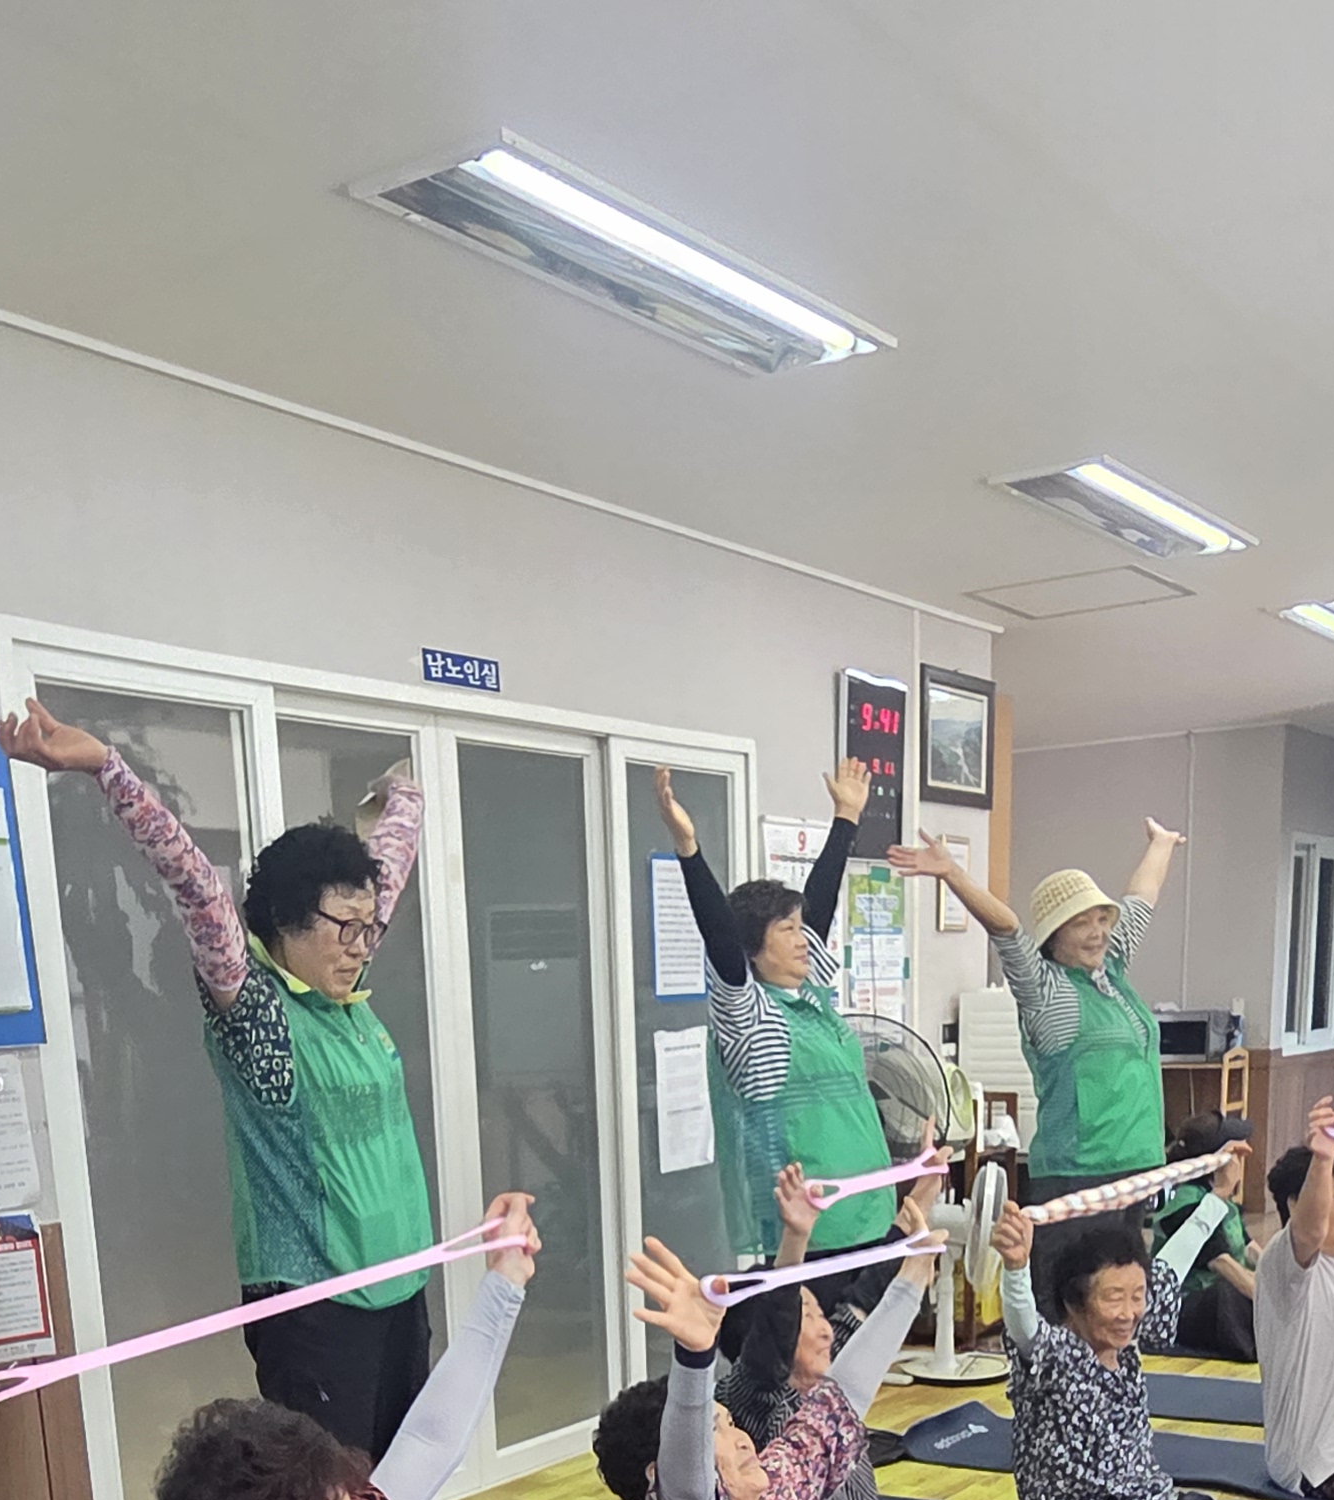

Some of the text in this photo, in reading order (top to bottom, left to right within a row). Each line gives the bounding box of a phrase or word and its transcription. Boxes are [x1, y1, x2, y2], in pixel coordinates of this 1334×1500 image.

[425, 652, 498, 689] 남노인실
[861, 703, 900, 735] 9:41
[797, 831, 807, 851] 9
